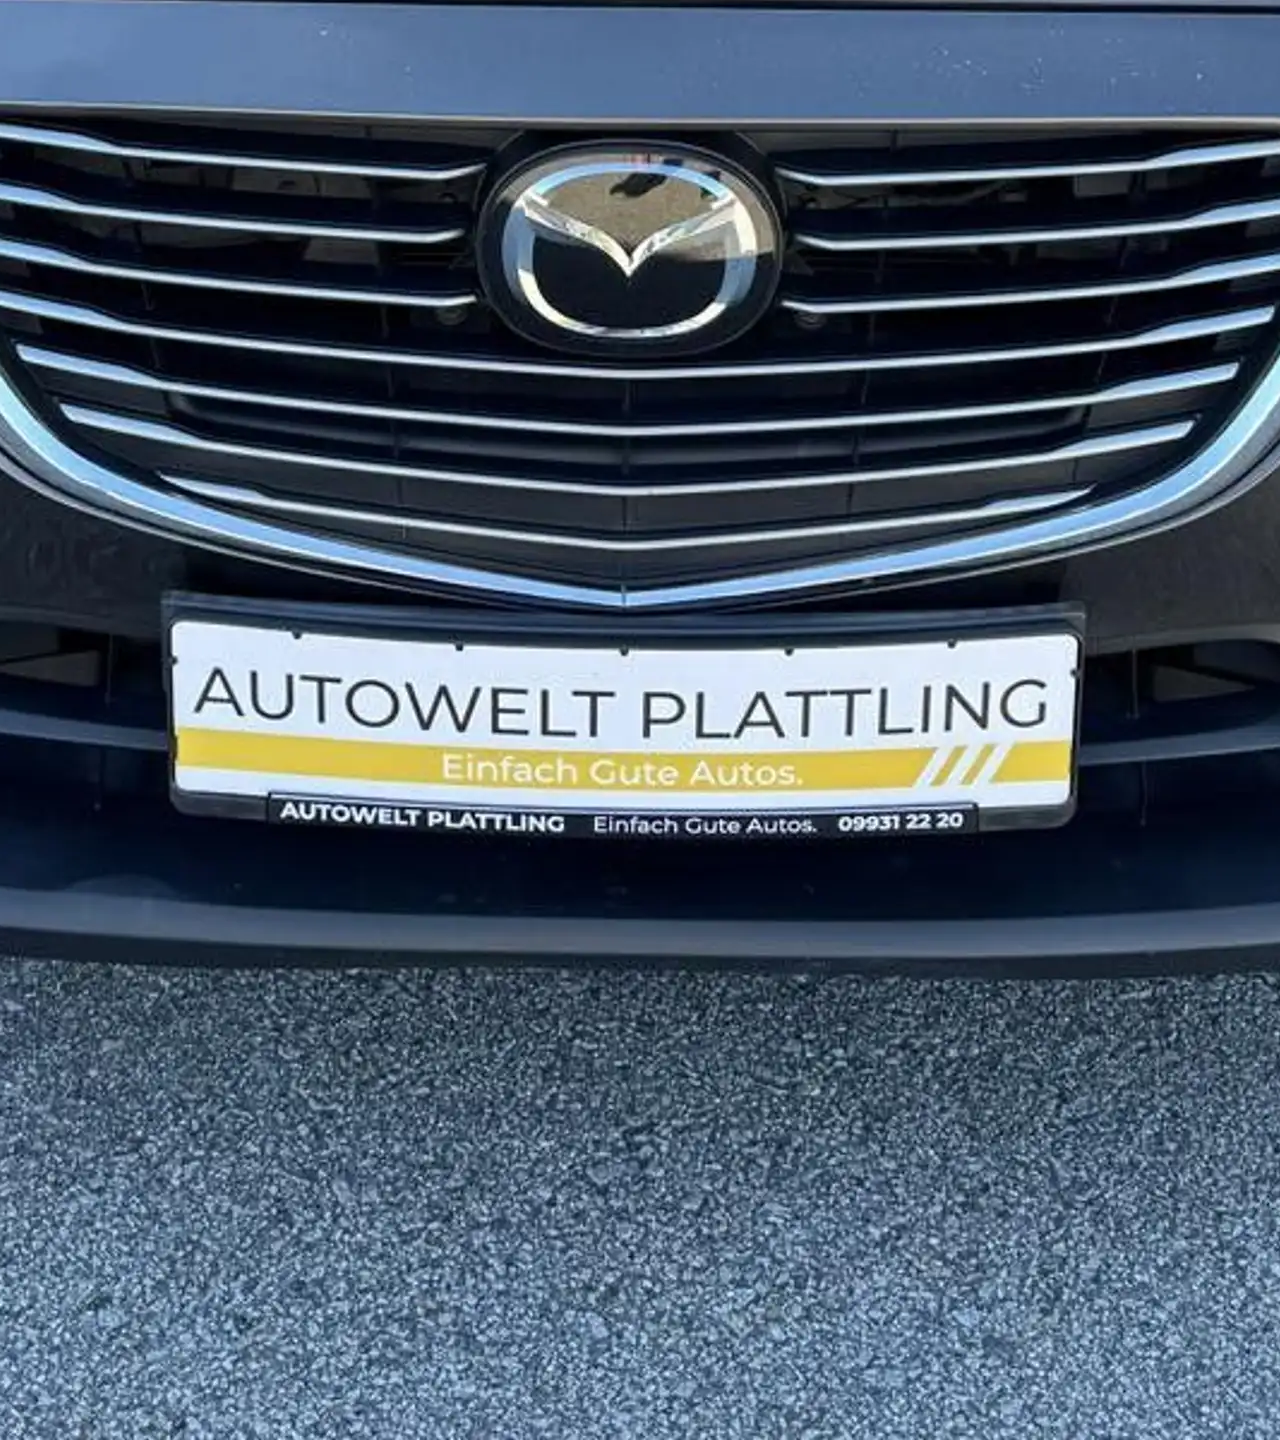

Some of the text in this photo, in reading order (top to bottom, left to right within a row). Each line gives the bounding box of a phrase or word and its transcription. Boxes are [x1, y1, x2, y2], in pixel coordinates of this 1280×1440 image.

[193, 666, 1047, 739] AUTOWELT PLATTLING
[442, 752, 803, 787] Einfach Gute Autos.
[280, 800, 964, 835] AUTOWELT PLATTLING Einfach Gute Autos. 09931 22 20
